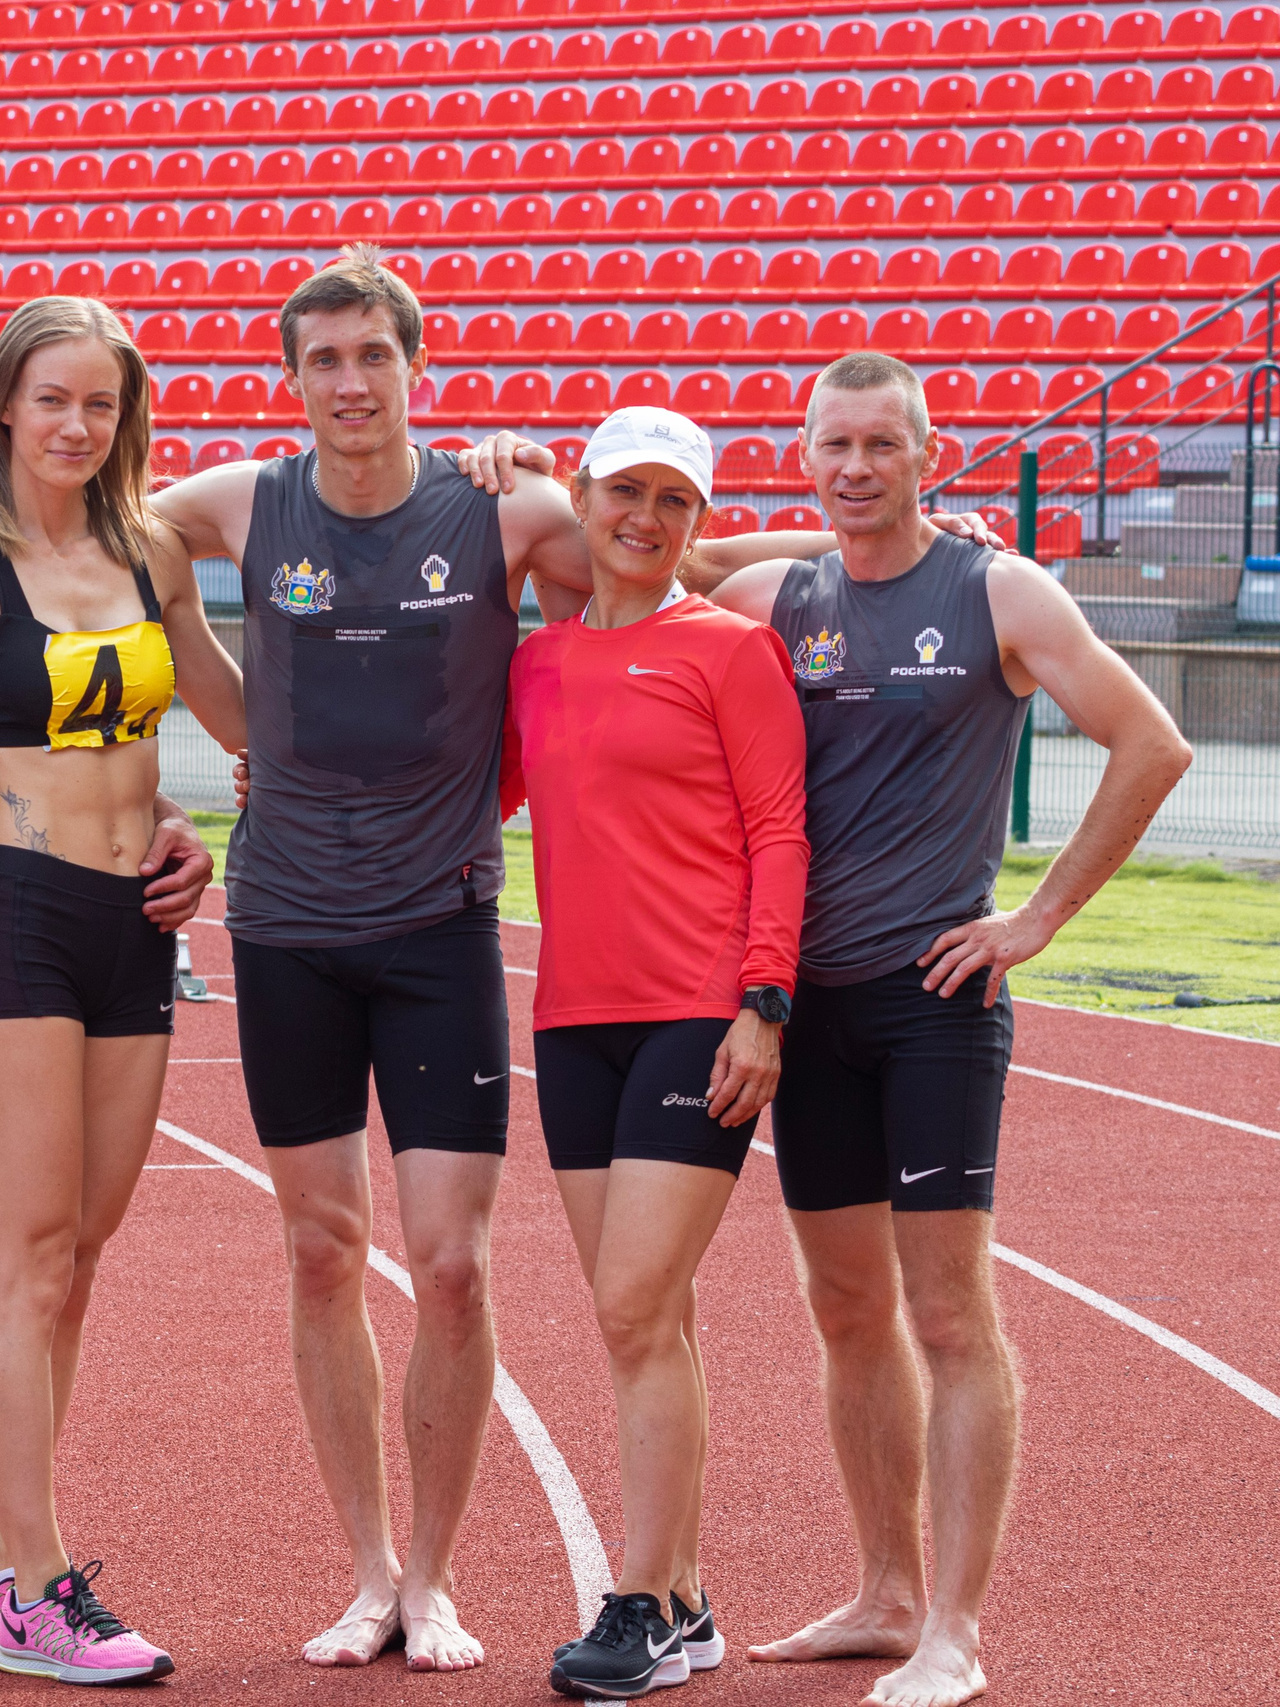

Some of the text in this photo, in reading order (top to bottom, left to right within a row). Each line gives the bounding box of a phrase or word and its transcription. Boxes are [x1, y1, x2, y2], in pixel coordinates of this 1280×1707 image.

[400, 592, 474, 611] РОСНЕФТЬ
[890, 666, 967, 676] РОСНЕФТЬ
[58, 644, 127, 745] 4
